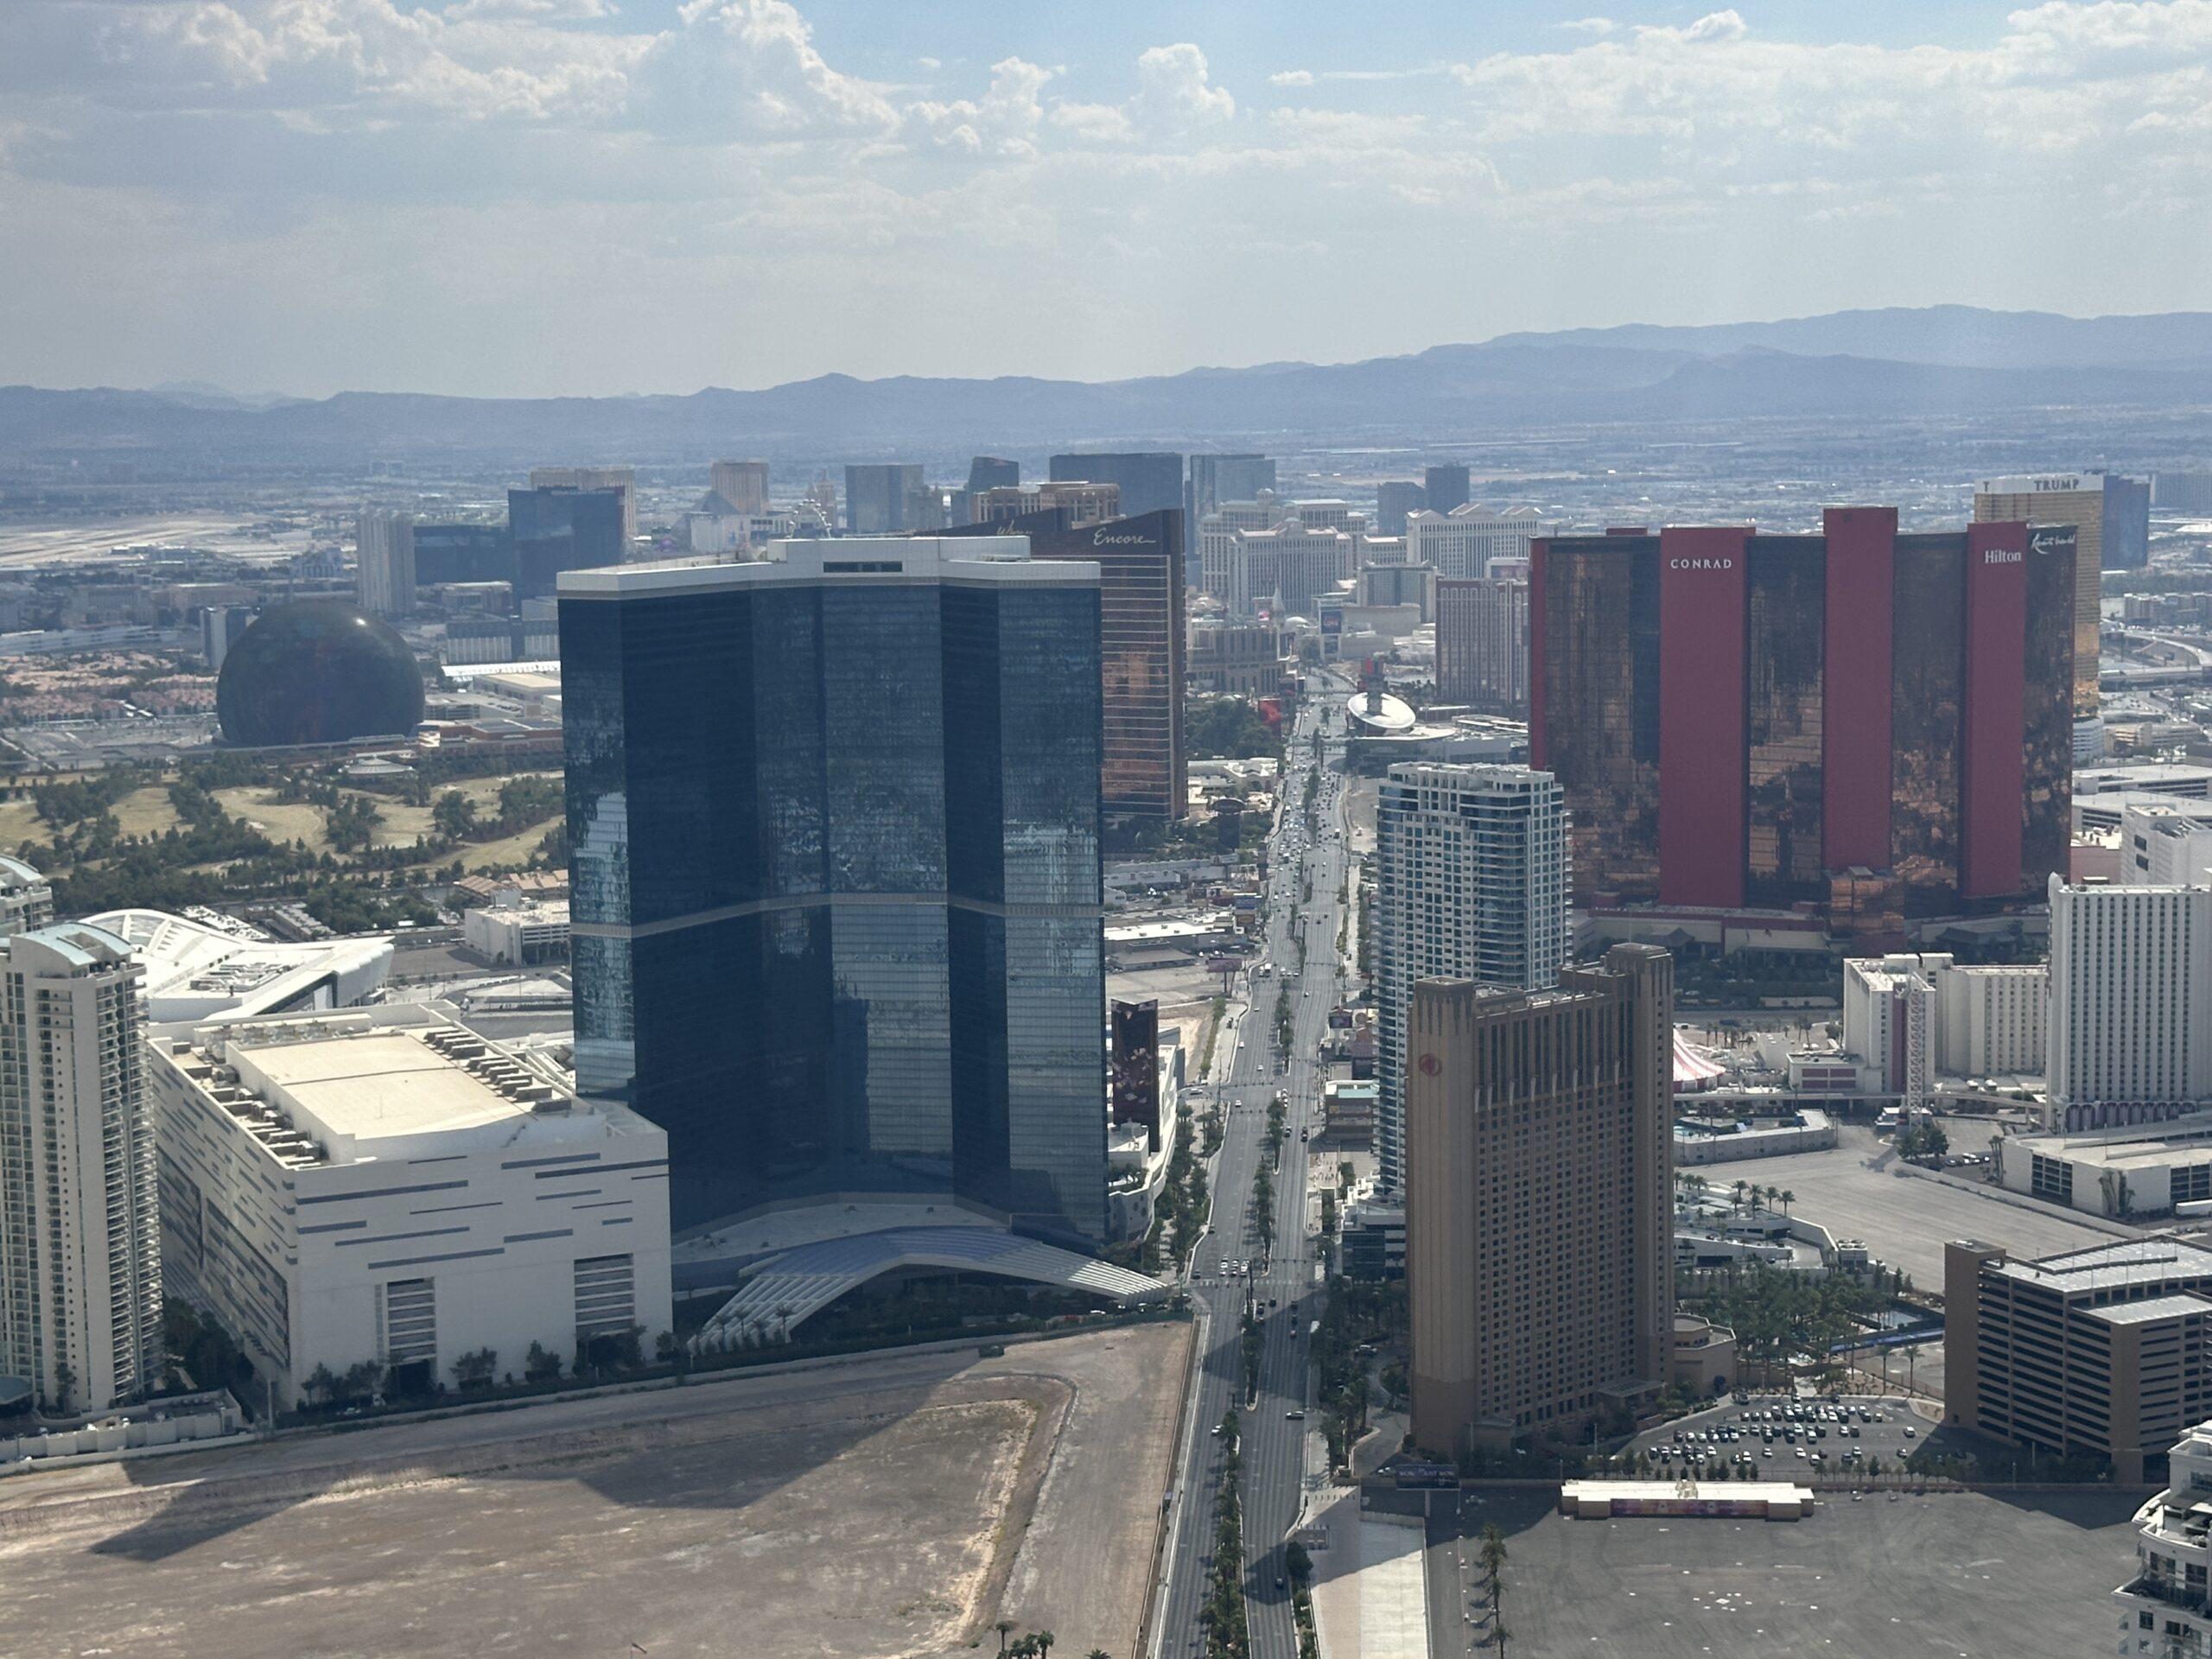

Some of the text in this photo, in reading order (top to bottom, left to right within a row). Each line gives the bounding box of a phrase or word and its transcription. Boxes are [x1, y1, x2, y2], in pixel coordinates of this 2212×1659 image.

[2034, 480, 2079, 492] TRUMP
[1094, 527, 1156, 546] Encore
[1985, 550, 2021, 563] Hilton
[1670, 558, 1732, 569] CONRAD
